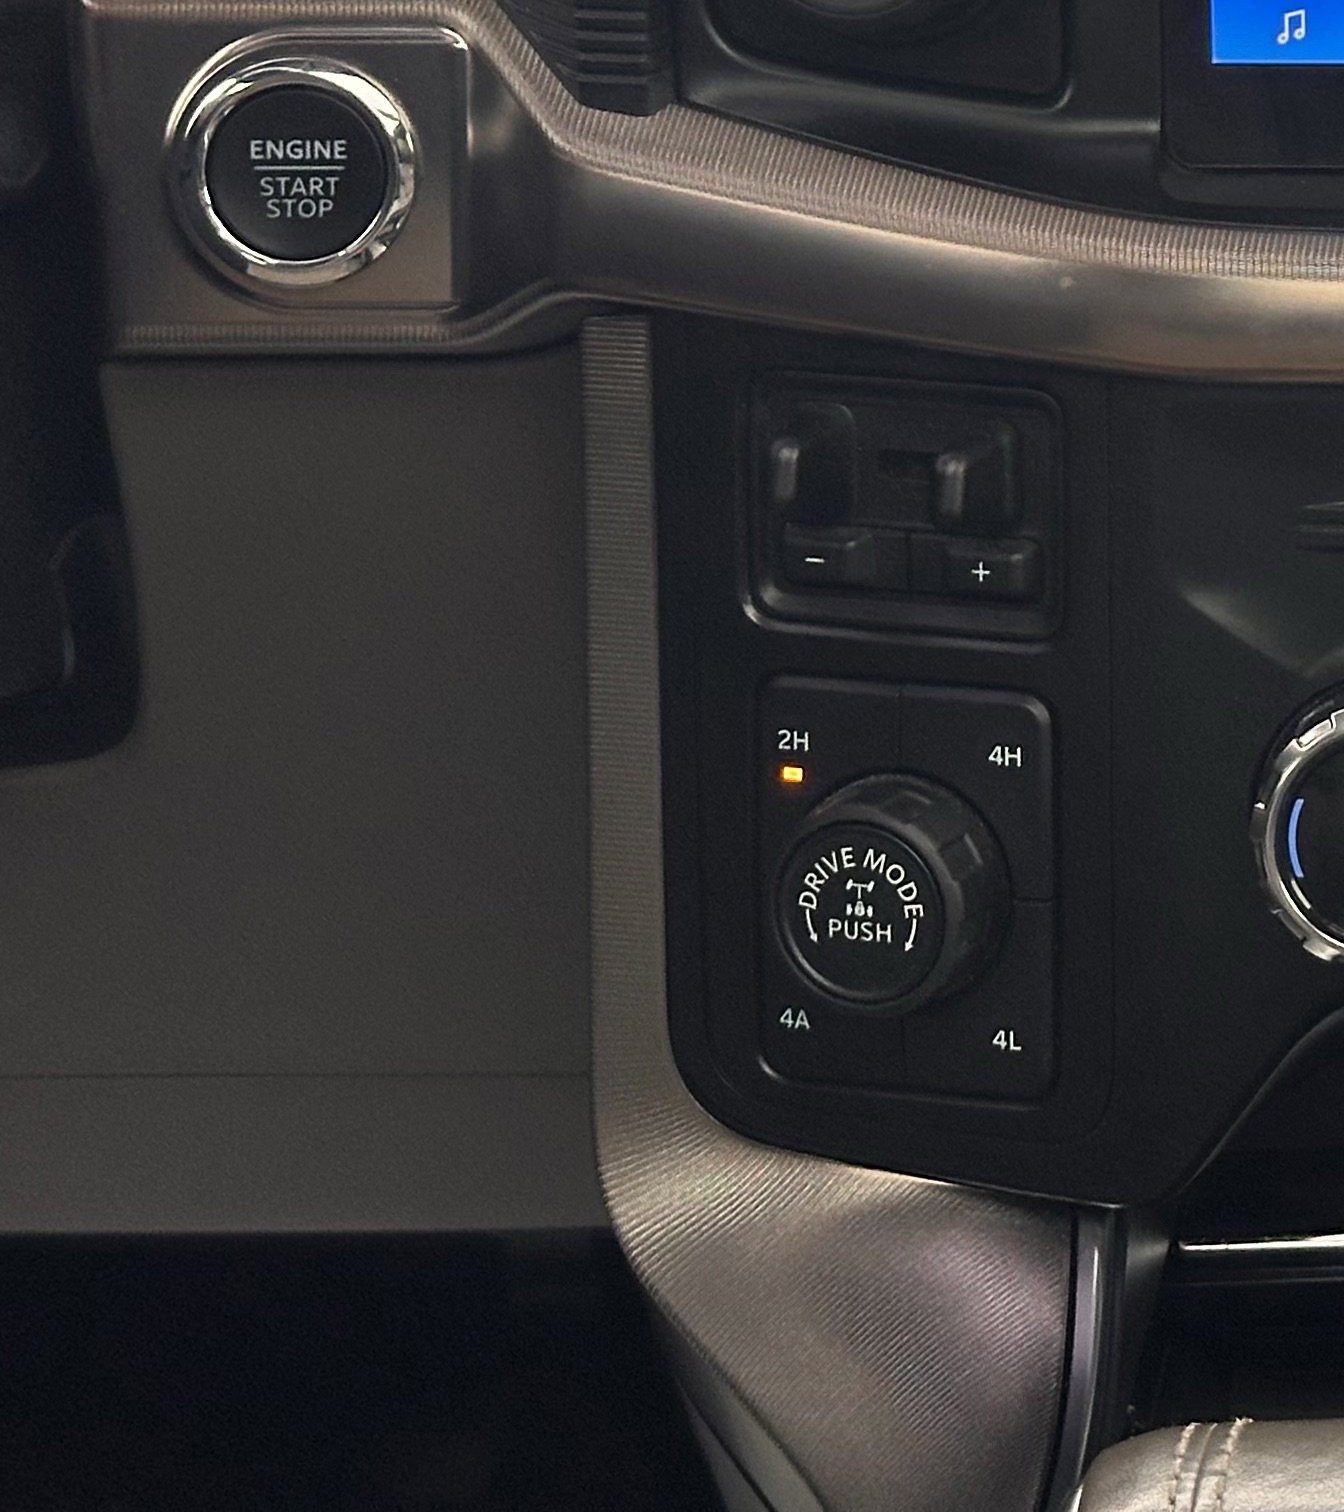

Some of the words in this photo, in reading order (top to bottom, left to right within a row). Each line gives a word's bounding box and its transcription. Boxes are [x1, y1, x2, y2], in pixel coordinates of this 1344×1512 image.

[250, 139, 348, 160] ENGINE
[260, 176, 340, 197] START
[266, 198, 334, 219] STOP
[777, 729, 810, 752] 2H
[988, 745, 1022, 767] 4H
[798, 846, 857, 910] DRIVE
[862, 847, 924, 918] MODE
[827, 917, 892, 944] PUSH
[779, 1007, 811, 1030] 4A
[991, 1029, 1022, 1051] 4L
